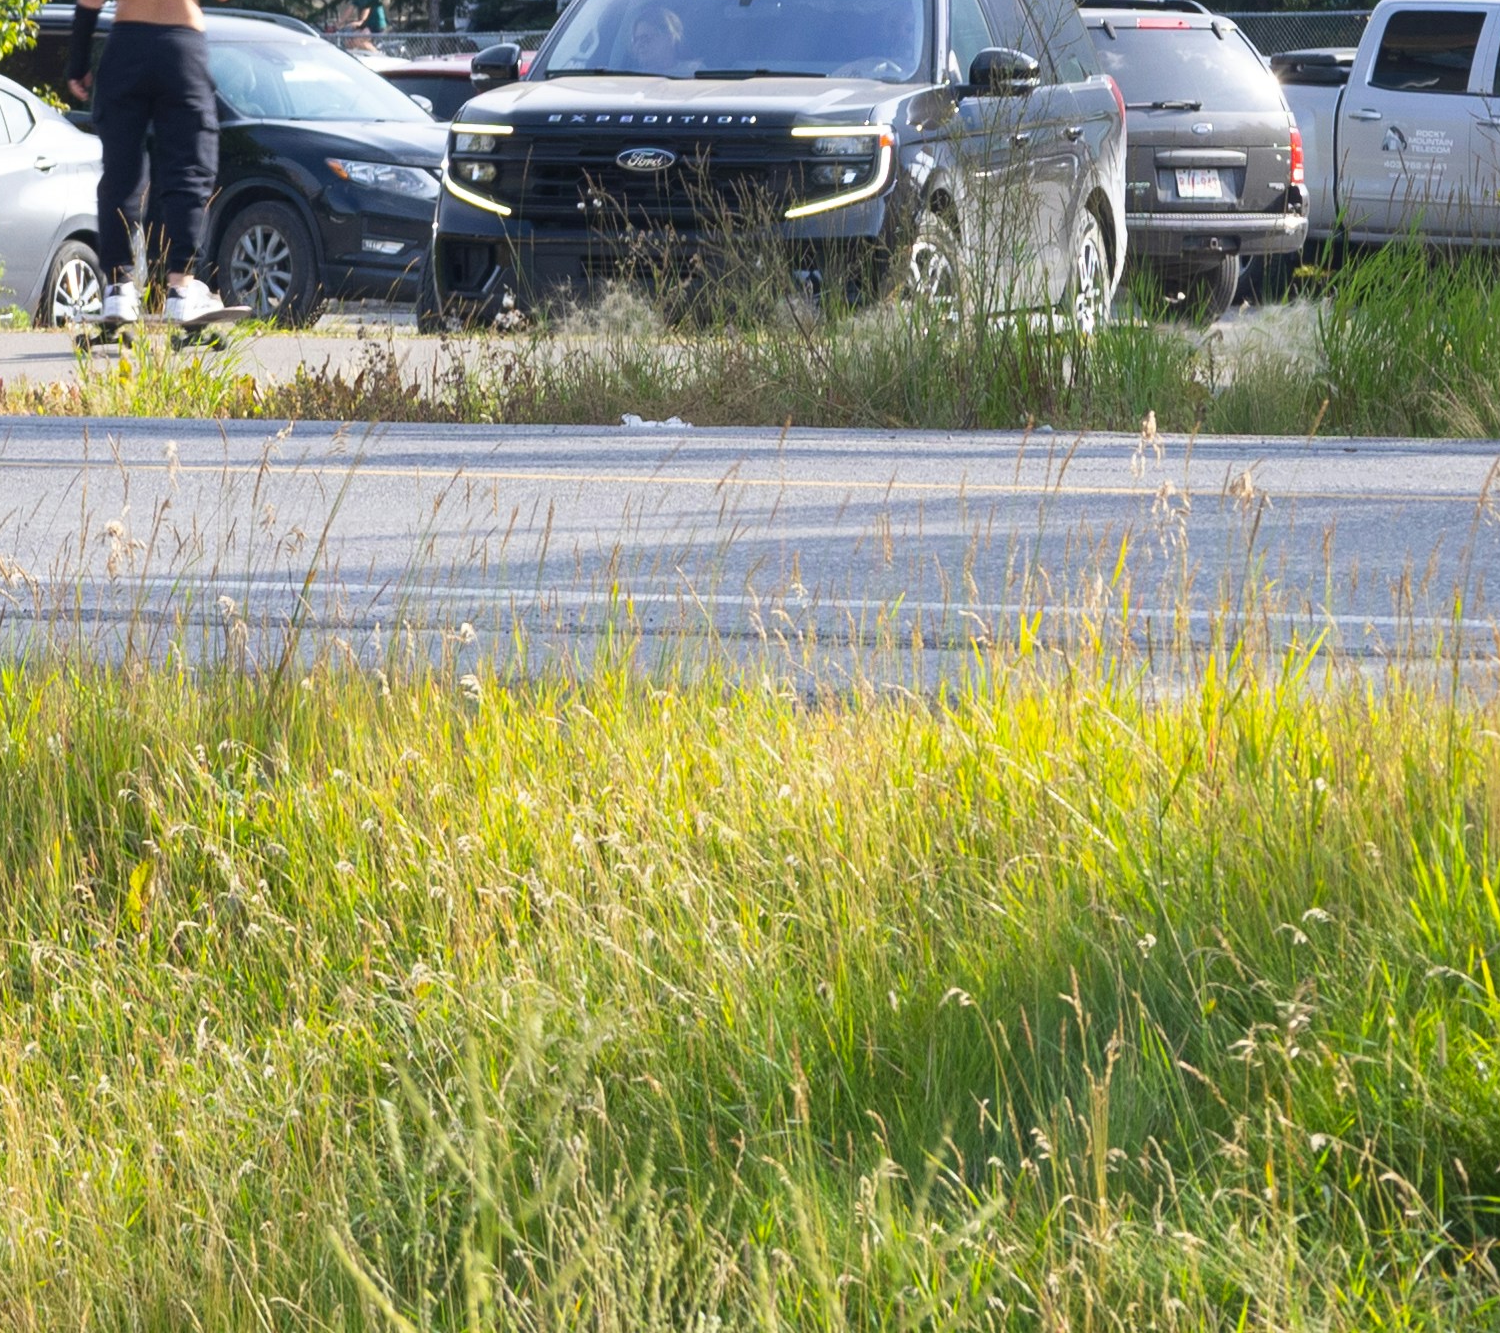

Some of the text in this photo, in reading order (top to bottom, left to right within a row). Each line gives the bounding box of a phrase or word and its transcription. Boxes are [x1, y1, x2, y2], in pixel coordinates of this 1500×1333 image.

[547, 113, 758, 125] EXPEDITION
[1416, 129, 1447, 139] ROCKY
[1408, 137, 1454, 147] MOUNTAIN
[1411, 145, 1451, 154] TELECOM
[626, 151, 665, 168] Ford
